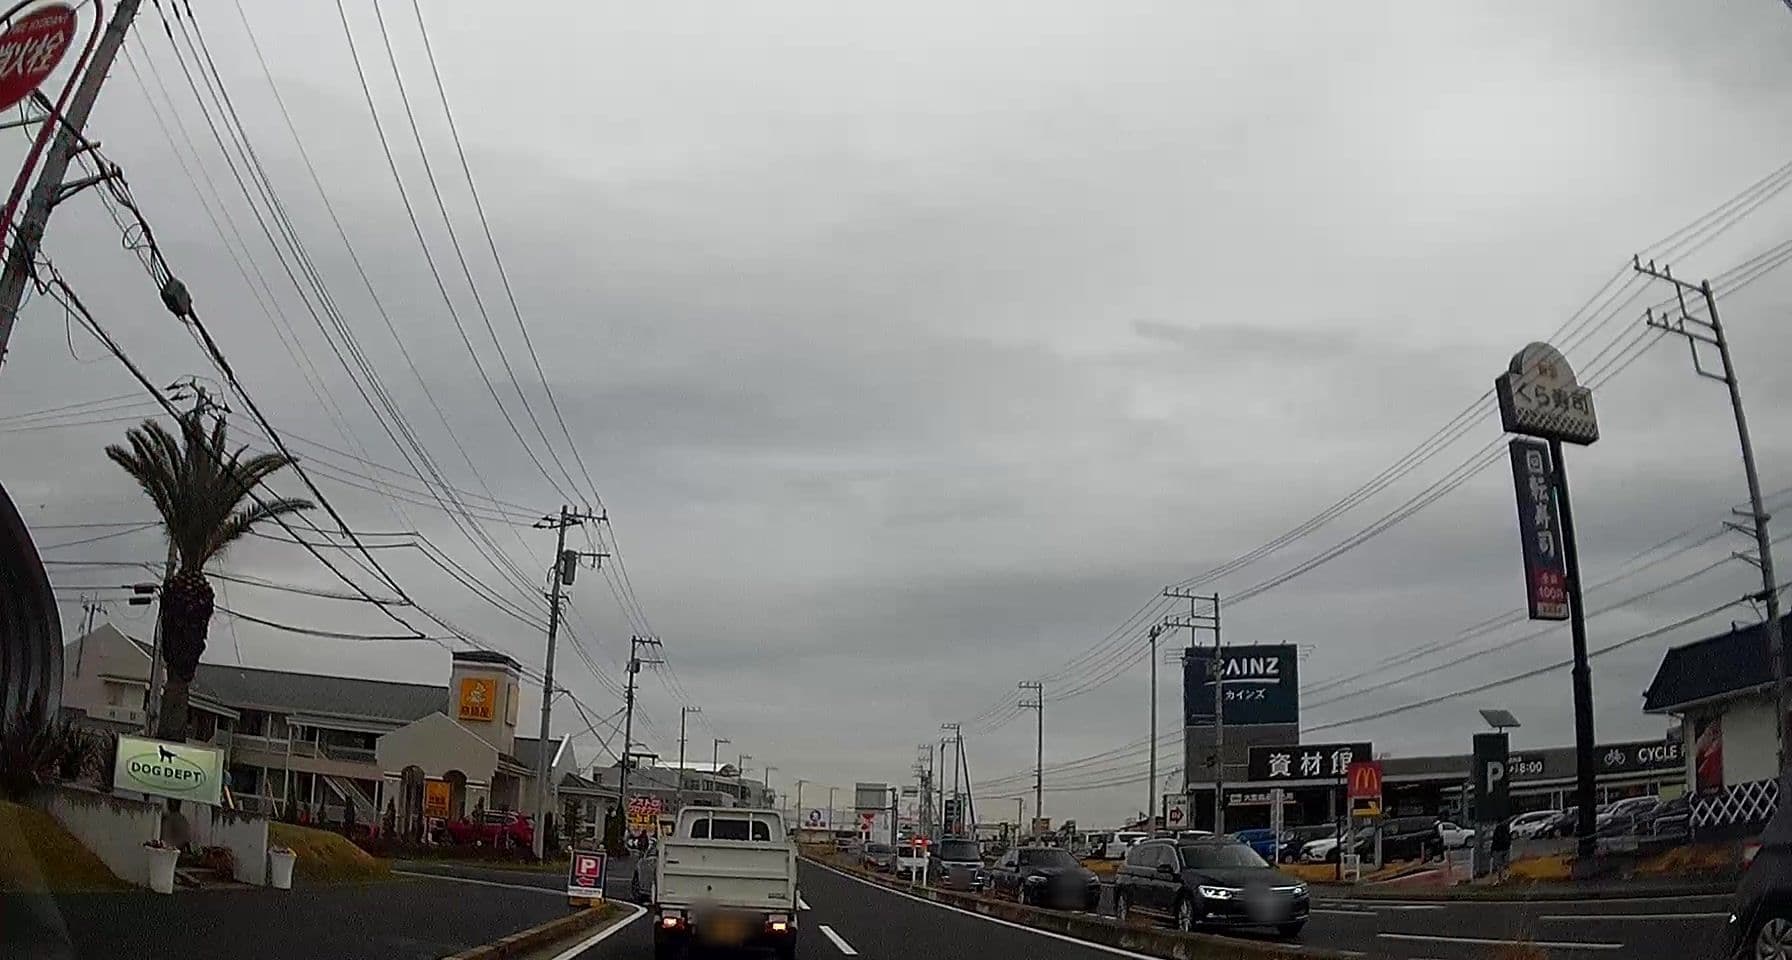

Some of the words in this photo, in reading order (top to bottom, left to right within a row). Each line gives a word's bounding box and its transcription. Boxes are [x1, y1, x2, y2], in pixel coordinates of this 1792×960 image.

[1225, 688, 1267, 701] カインズ
[1638, 745, 1678, 763] CYCLE
[131, 762, 161, 776] DOG
[164, 767, 202, 782] DEPT
[1487, 761, 1504, 794] P
[580, 858, 597, 874] P
